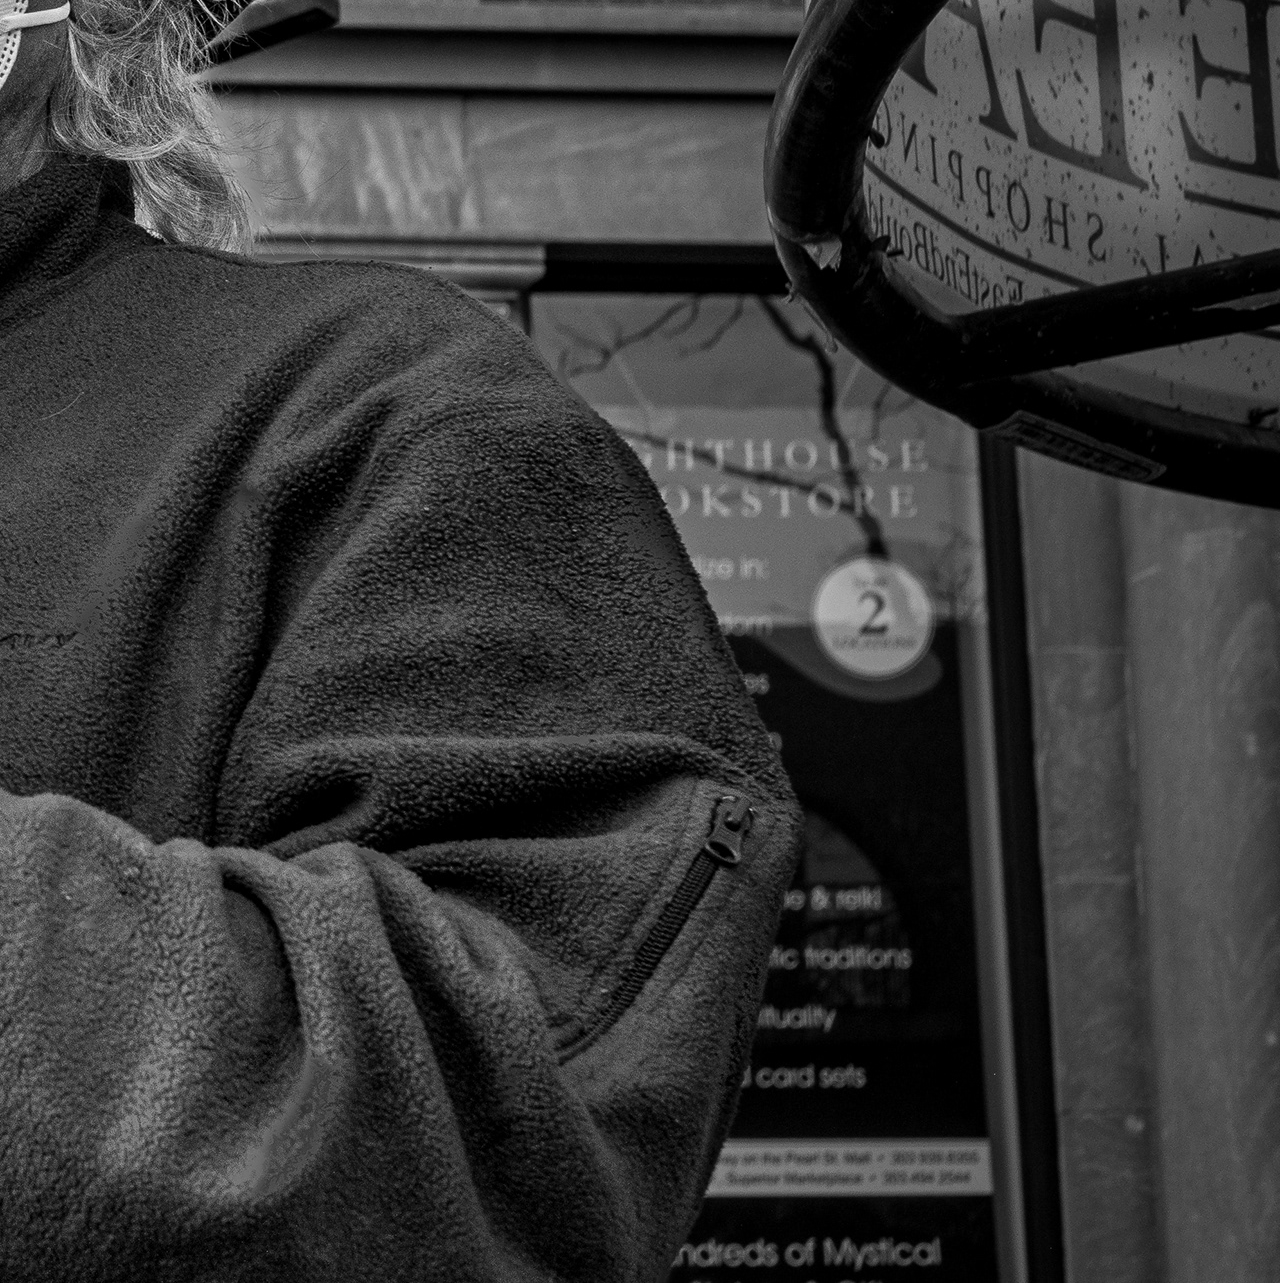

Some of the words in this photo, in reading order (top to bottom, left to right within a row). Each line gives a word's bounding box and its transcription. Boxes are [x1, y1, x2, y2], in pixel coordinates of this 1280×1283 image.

[858, 590, 889, 636] 2
[755, 1064, 816, 1089] card
[785, 1237, 816, 1267] of
[823, 1236, 942, 1271] Mystical
